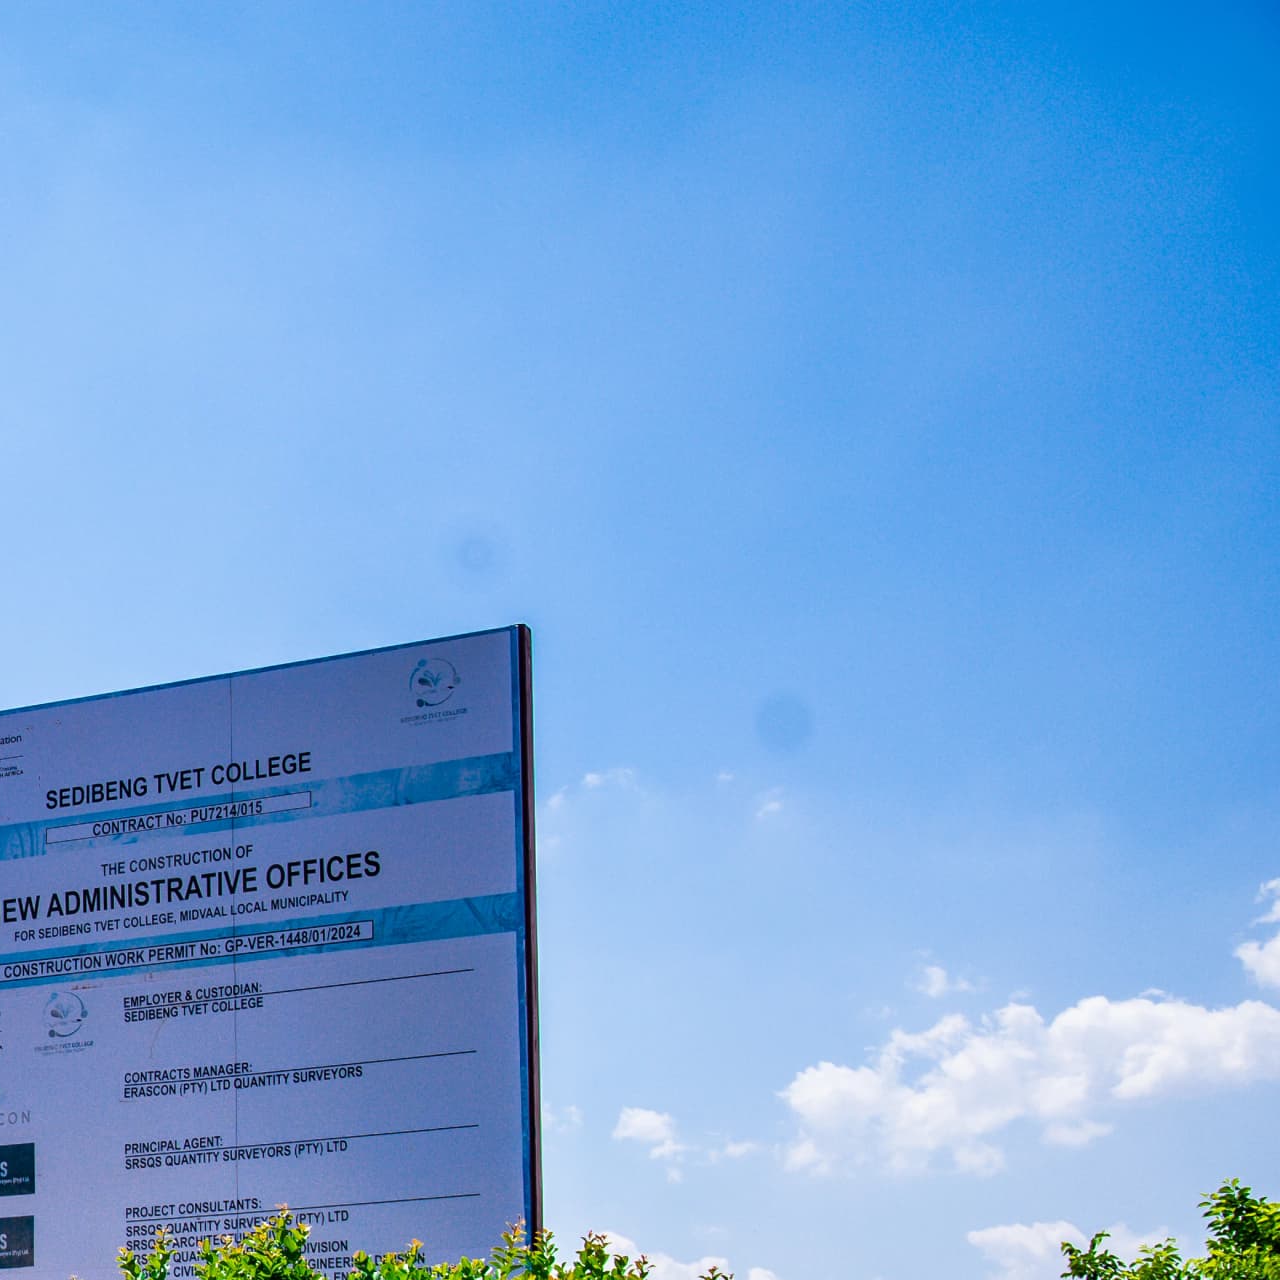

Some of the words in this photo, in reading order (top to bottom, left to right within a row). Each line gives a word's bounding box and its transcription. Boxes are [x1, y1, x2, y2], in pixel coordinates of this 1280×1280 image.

[46, 777, 147, 809] SEDIBENG
[154, 768, 205, 793] TVET
[211, 752, 311, 785] COLLEGE
[92, 814, 163, 836] CONTRACT
[166, 811, 186, 826] No:
[191, 800, 263, 823] PU7214/015
[101, 861, 126, 876] THE
[129, 848, 231, 873] CONSTRUCTION
[235, 845, 253, 859] OF
[46, 867, 257, 918] ADMINISTRATIVE
[266, 850, 381, 889] OFFICES
[14, 931, 36, 942] FOR
[38, 922, 91, 939] SEDIBENG
[94, 919, 121, 932] TVET
[123, 912, 177, 929] COLLEGE,
[180, 906, 227, 922] MIDVAAL
[231, 900, 268, 916] LOCAL
[271, 890, 350, 910] MUNICIPALITY
[4, 955, 102, 979] CONSTRUCTION
[105, 949, 145, 967] WORK
[148, 944, 196, 962] PERMIT
[200, 942, 221, 956] No:
[224, 924, 361, 953] GP-VER-1448/01/2024
[123, 991, 182, 1008] EMPLOYER
[185, 990, 192, 1001] &
[195, 982, 262, 1000] CUSTODIAN:
[124, 1005, 178, 1023] SEDIBENG
[182, 1002, 209, 1016] TVET
[211, 997, 263, 1013] COLLEGE
[124, 1068, 191, 1084] CONTRACTS
[193, 1062, 253, 1078] MANAGER:
[124, 1083, 176, 1099] ERASCON
[179, 1080, 208, 1097] (PTY)
[210, 1079, 231, 1092] LTD
[233, 1073, 290, 1089] QUANTITY
[292, 1066, 363, 1083] SURVEYORS
[124, 1139, 181, 1155] PRINCIPAL
[183, 1135, 223, 1149] AGENT:
[125, 1156, 162, 1170] SRSQS
[165, 1151, 220, 1167] QUANTITY
[222, 1144, 291, 1162] SURVEYORS
[294, 1142, 323, 1158] (PTY)
[326, 1139, 348, 1153] LTD
[125, 1203, 175, 1219] PROJECT
[178, 1197, 262, 1215] CONSULTANTS:
[126, 1224, 163, 1237] SRSQS
[165, 1219, 221, 1234] QUANTITY
[223, 1213, 292, 1230] SURVEYOS
[295, 1211, 324, 1227] (PTY)
[328, 1209, 349, 1223] LTD
[126, 1238, 159, 1251] SRSQ
[300, 1240, 348, 1254] DIVISION
